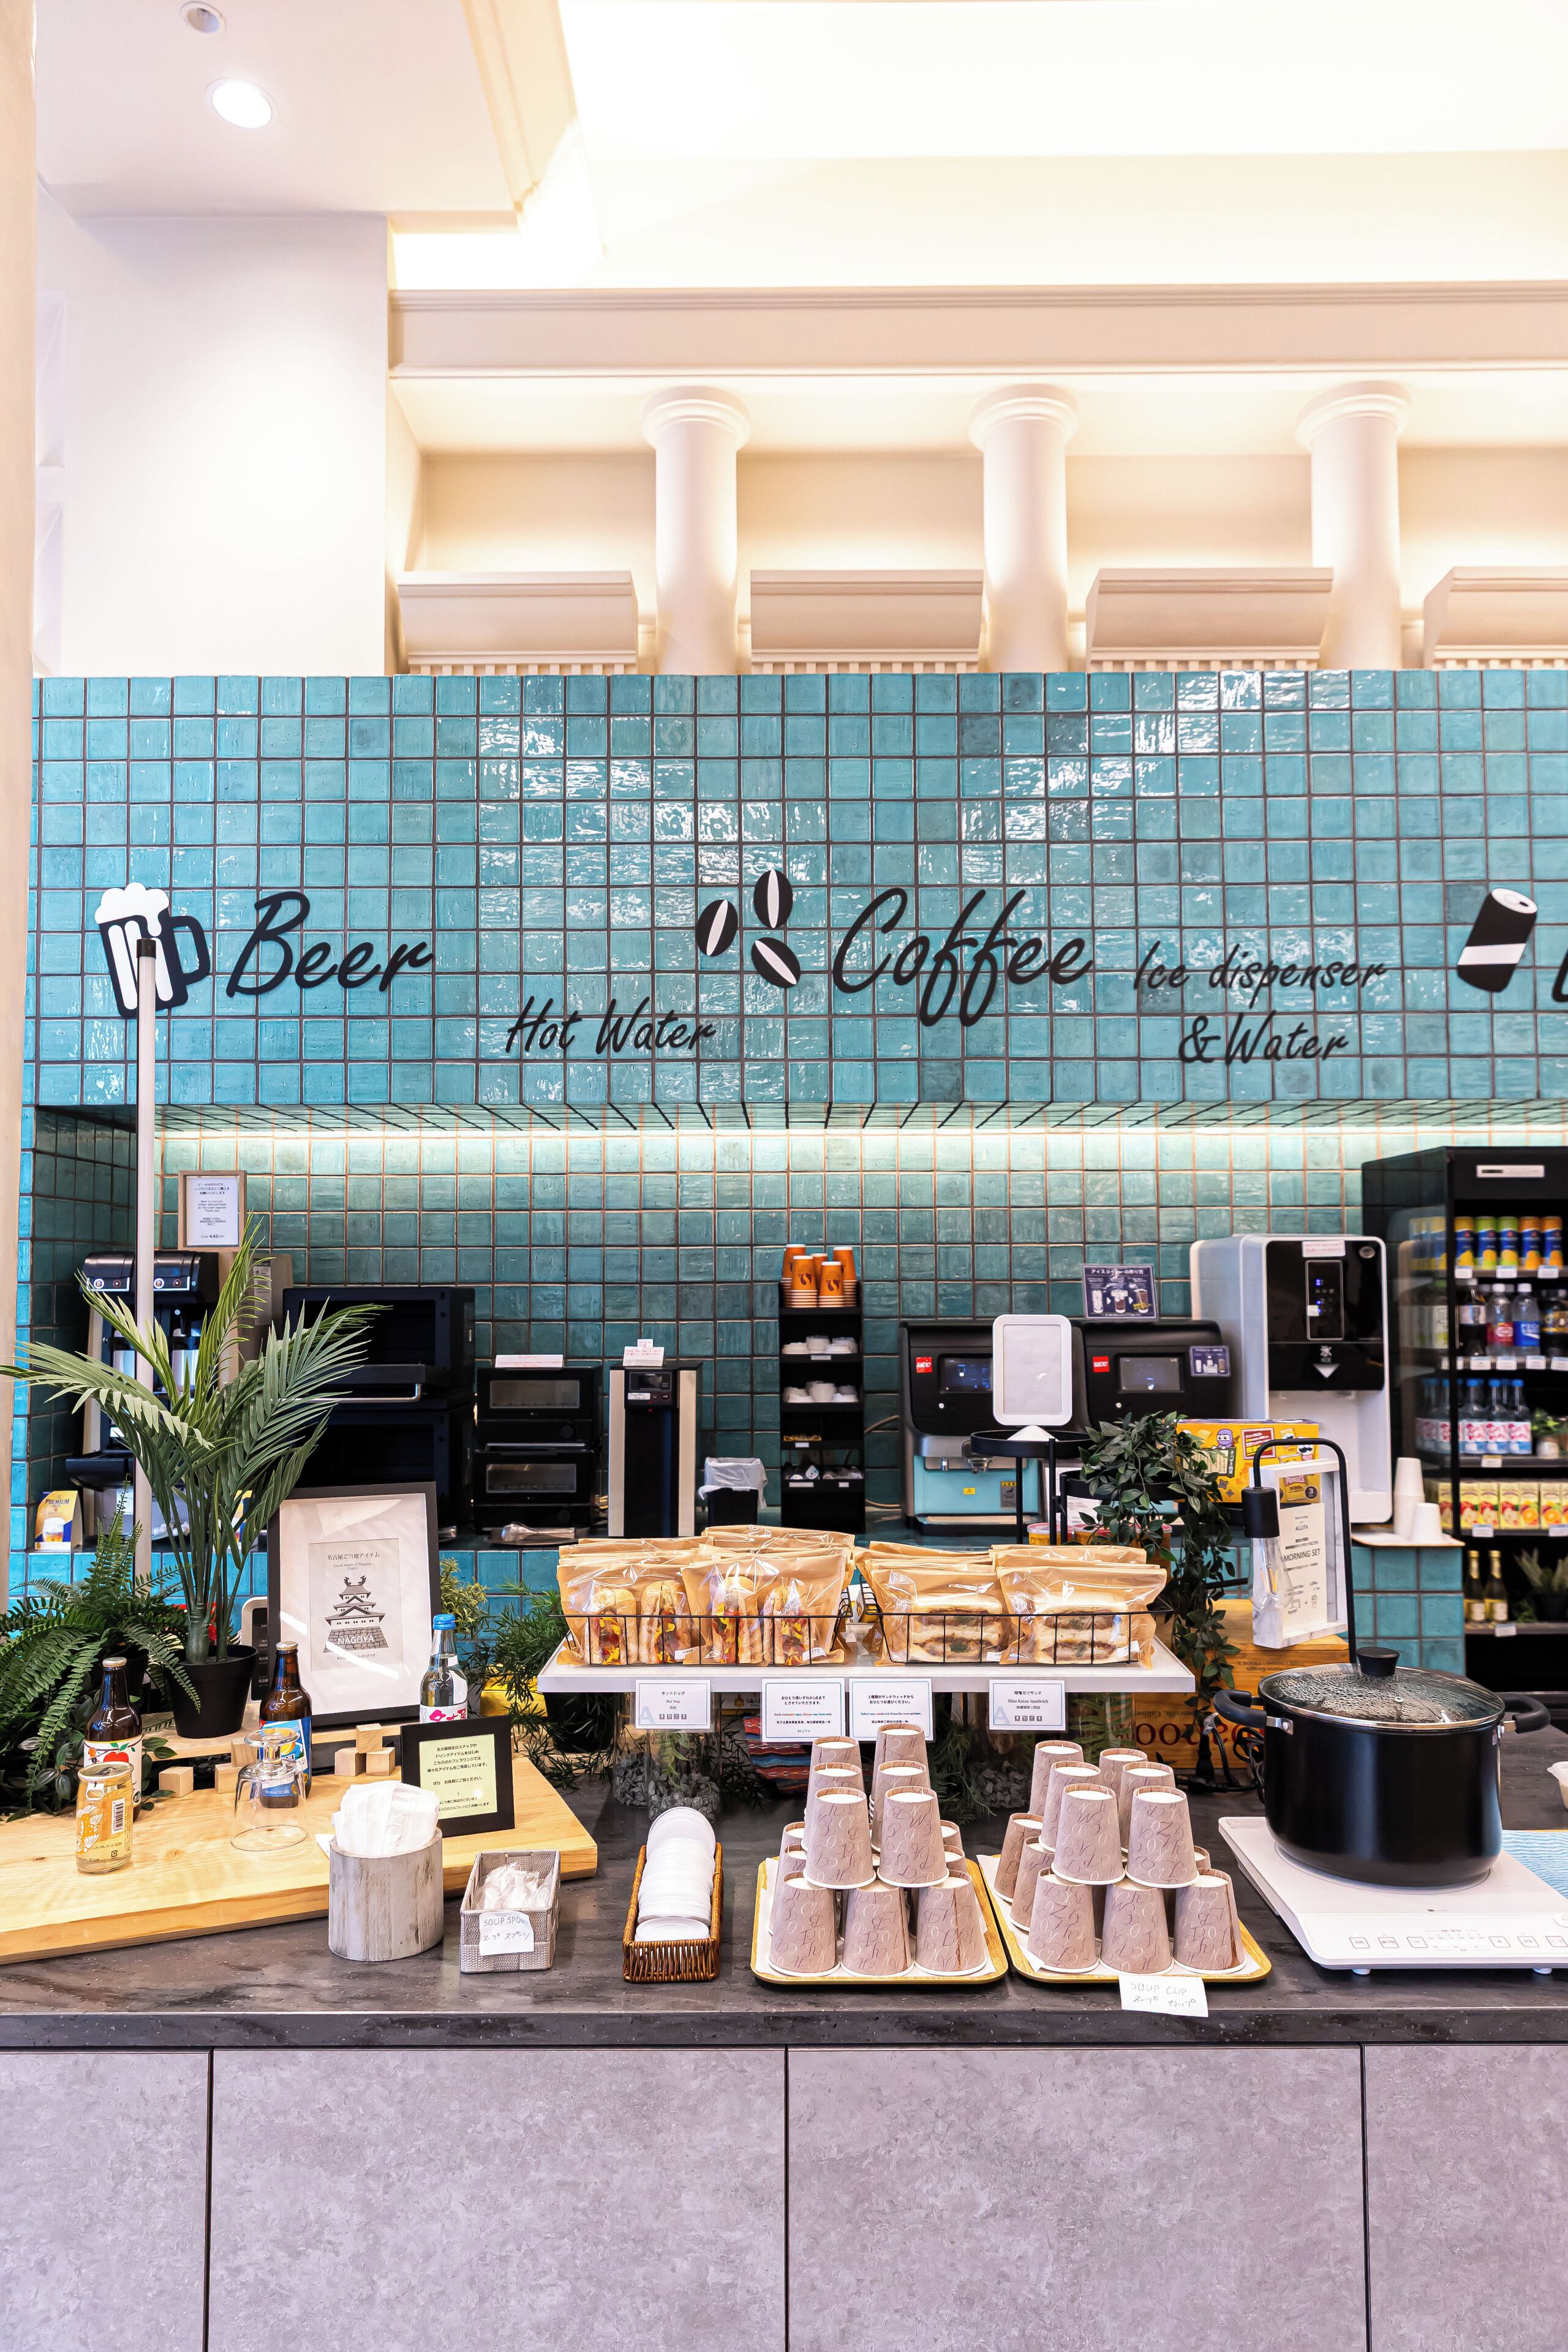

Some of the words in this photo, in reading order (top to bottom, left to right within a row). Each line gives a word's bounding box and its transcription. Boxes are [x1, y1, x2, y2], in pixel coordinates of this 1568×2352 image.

[226, 890, 434, 998] Beer
[831, 887, 1094, 1027] Coffee
[1133, 941, 1191, 991] Ice
[1208, 943, 1387, 1008] dispenser
[505, 996, 581, 1052] Hot
[595, 997, 716, 1055] Water
[337, 1635, 375, 1645] NAGOYA
[433, 1756, 481, 1765] こちらのカフェラウンジでは
[435, 1750, 480, 1758] ドリンクアイテムをはじめ
[483, 1917, 504, 1926] SOUP
[1131, 1981, 1159, 1992] SOUP
[1166, 1986, 1187, 1996] CUP
